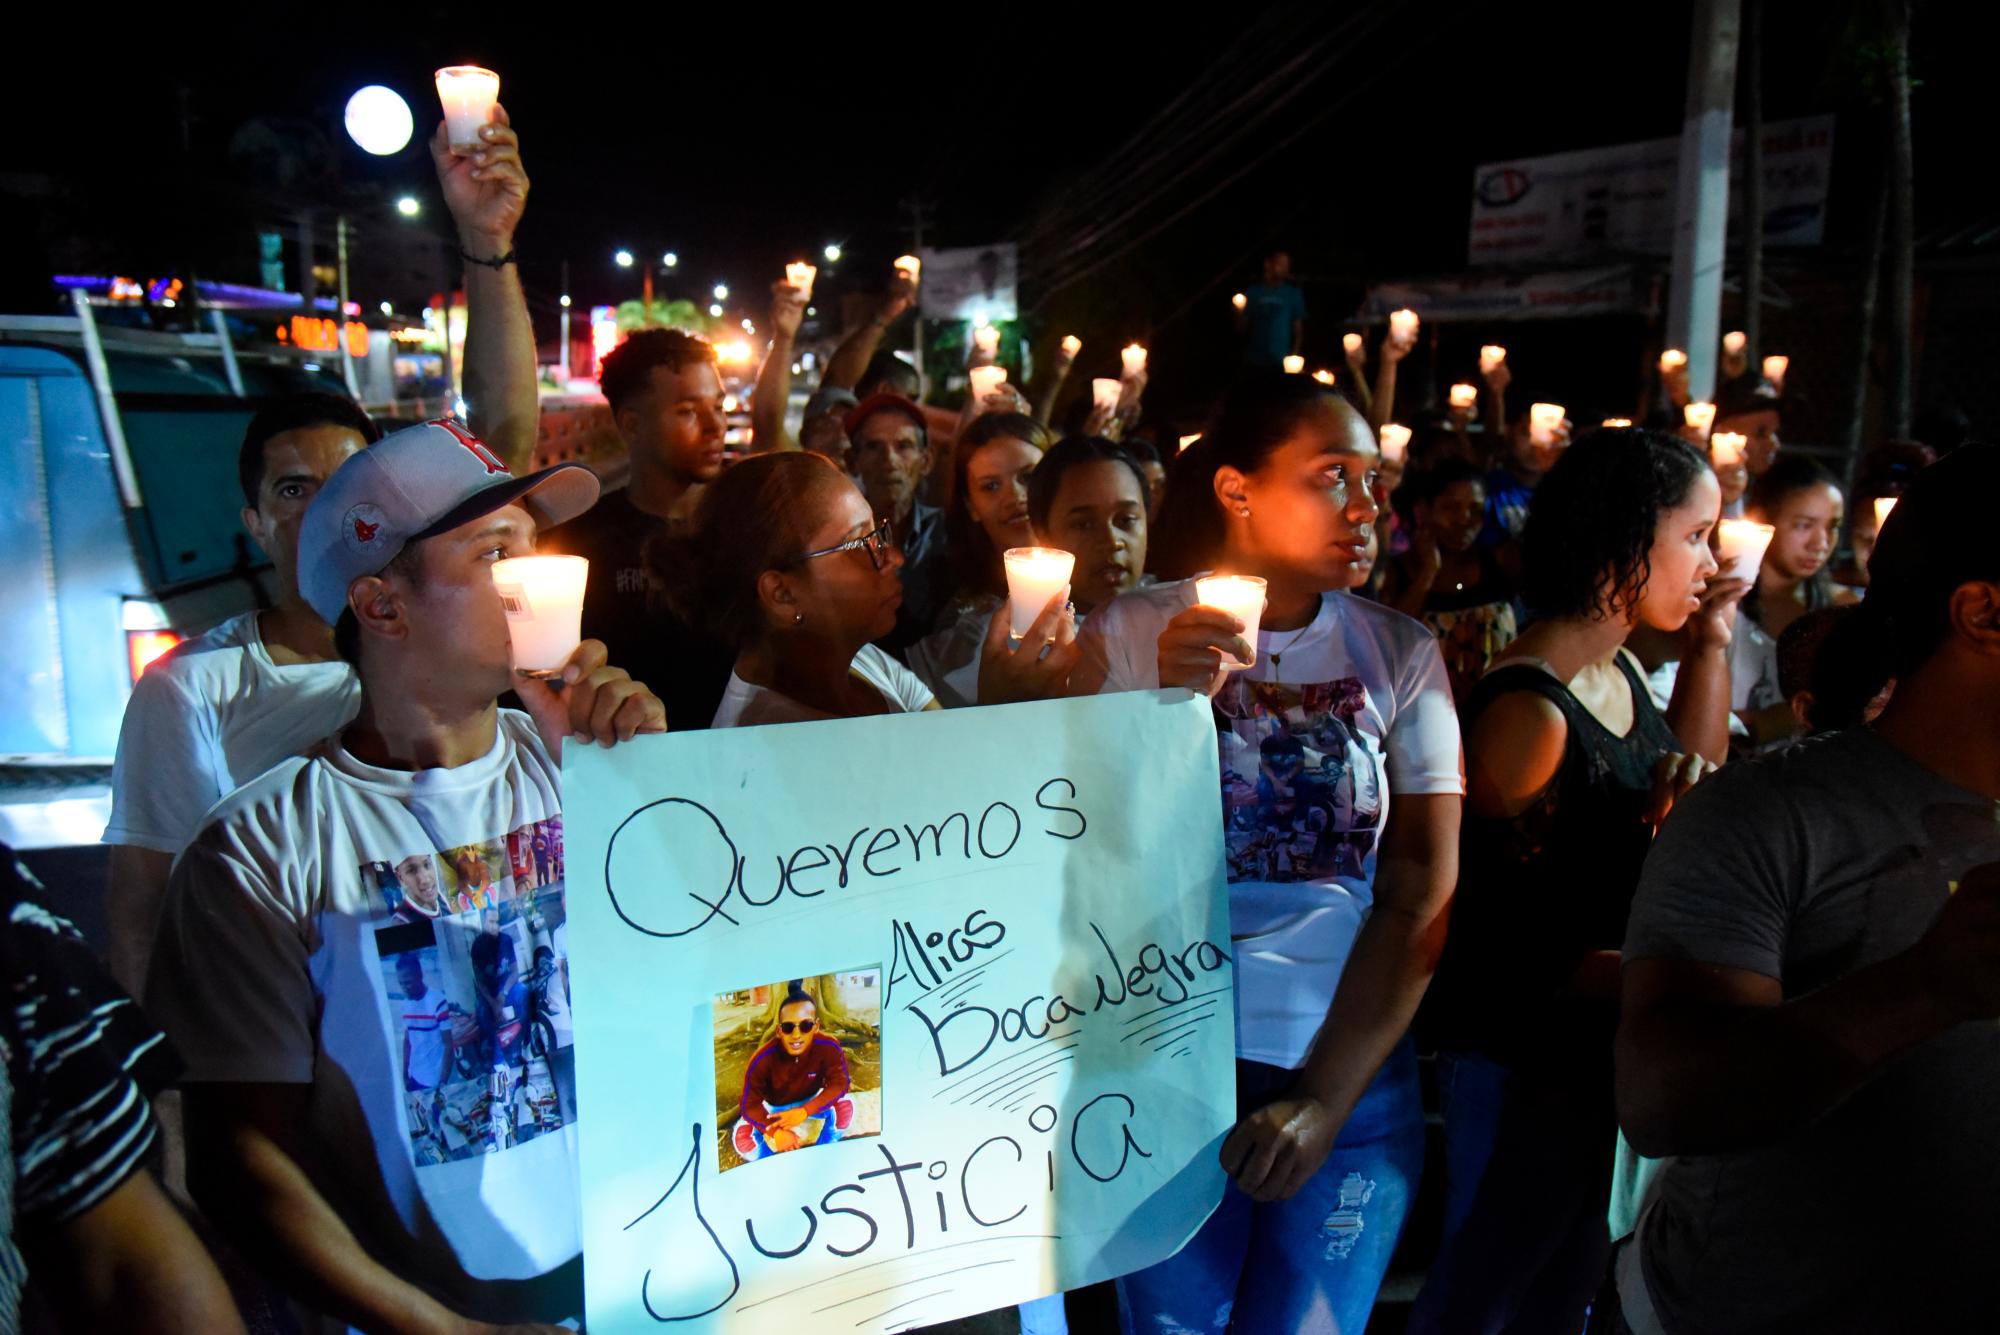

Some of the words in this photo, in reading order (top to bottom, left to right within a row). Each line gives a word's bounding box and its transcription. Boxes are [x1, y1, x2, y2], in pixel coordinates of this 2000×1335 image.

[605, 777, 1087, 938] Queremos
[884, 909, 1006, 1010] Alias
[1093, 920, 1233, 1012] Negra
